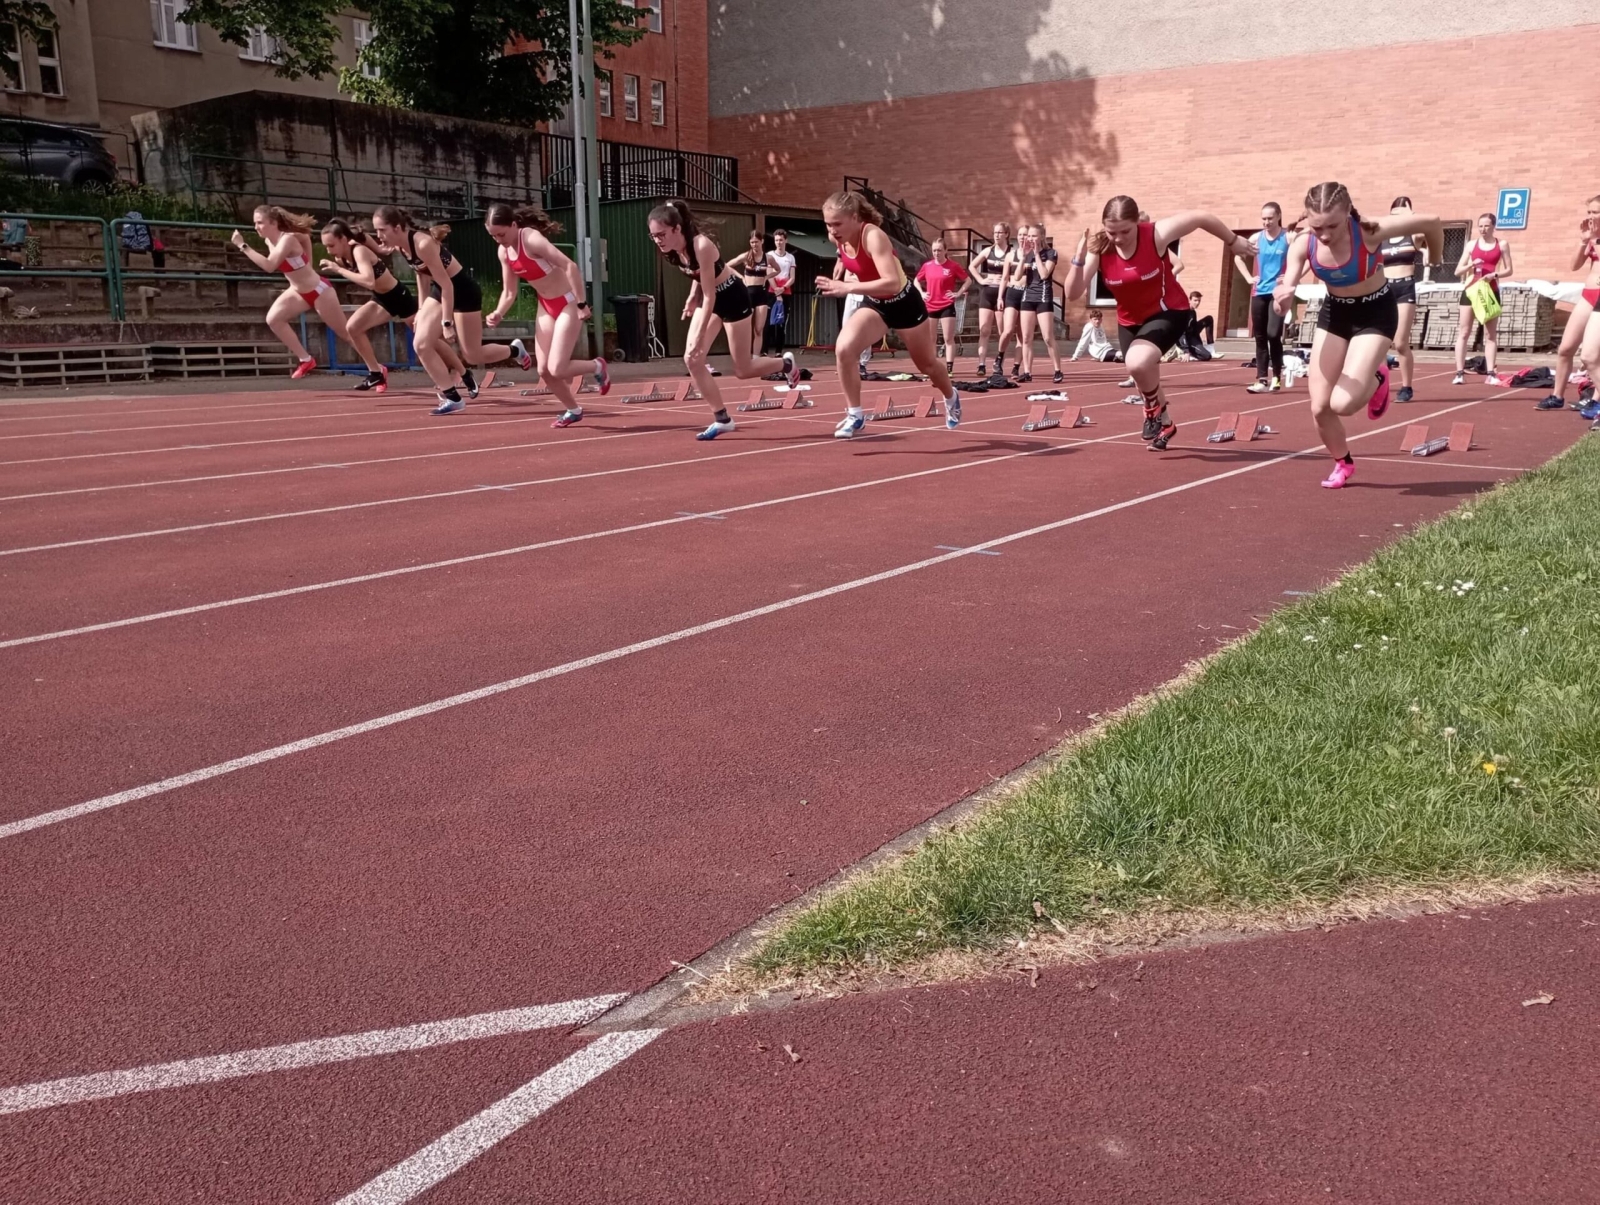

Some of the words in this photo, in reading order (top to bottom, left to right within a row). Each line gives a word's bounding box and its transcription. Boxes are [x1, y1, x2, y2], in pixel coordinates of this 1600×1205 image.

[1503, 193, 1522, 217] P
[884, 291, 906, 304] NIKE
[1362, 286, 1388, 303] NIKE
